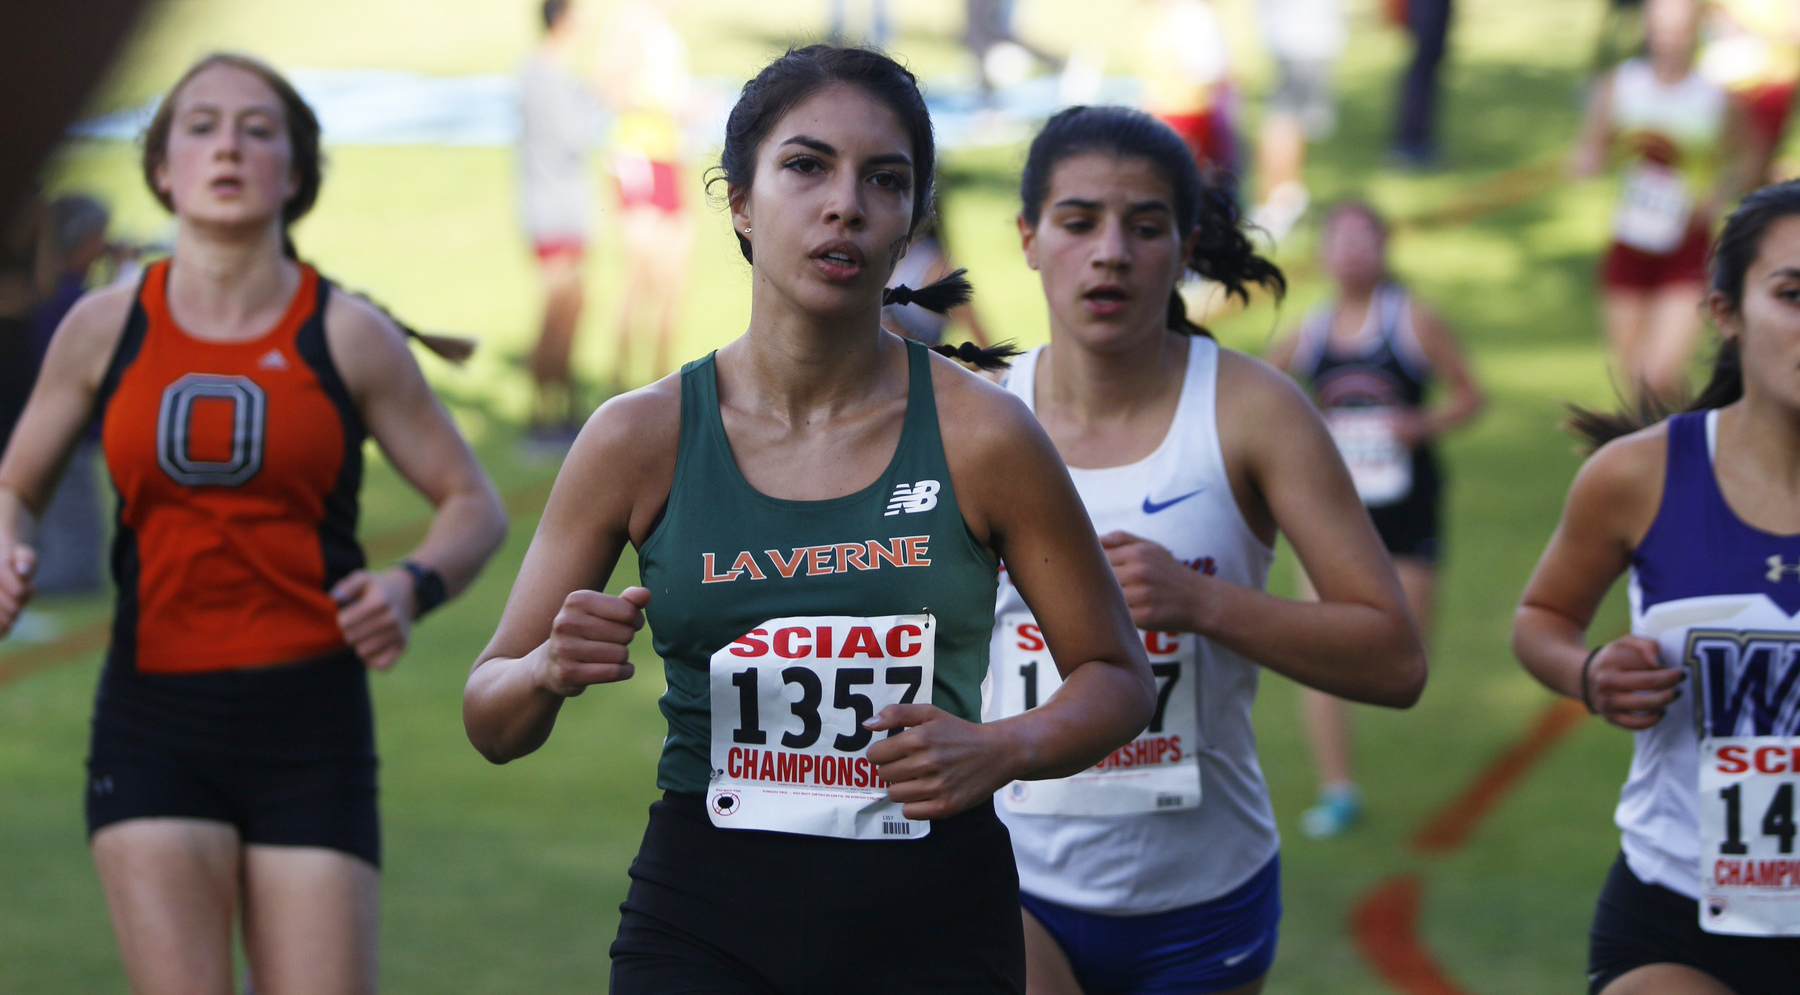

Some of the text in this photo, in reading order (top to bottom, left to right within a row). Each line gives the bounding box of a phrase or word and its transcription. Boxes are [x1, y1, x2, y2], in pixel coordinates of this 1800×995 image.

[157, 372, 267, 487] O
[884, 479, 941, 516] NB
[729, 624, 922, 659] SCIAC
[731, 666, 923, 753] 1357
[1019, 660, 1182, 733] 17
[727, 746, 896, 788] CHAMPIONSH
[1719, 781, 1798, 855] 14
